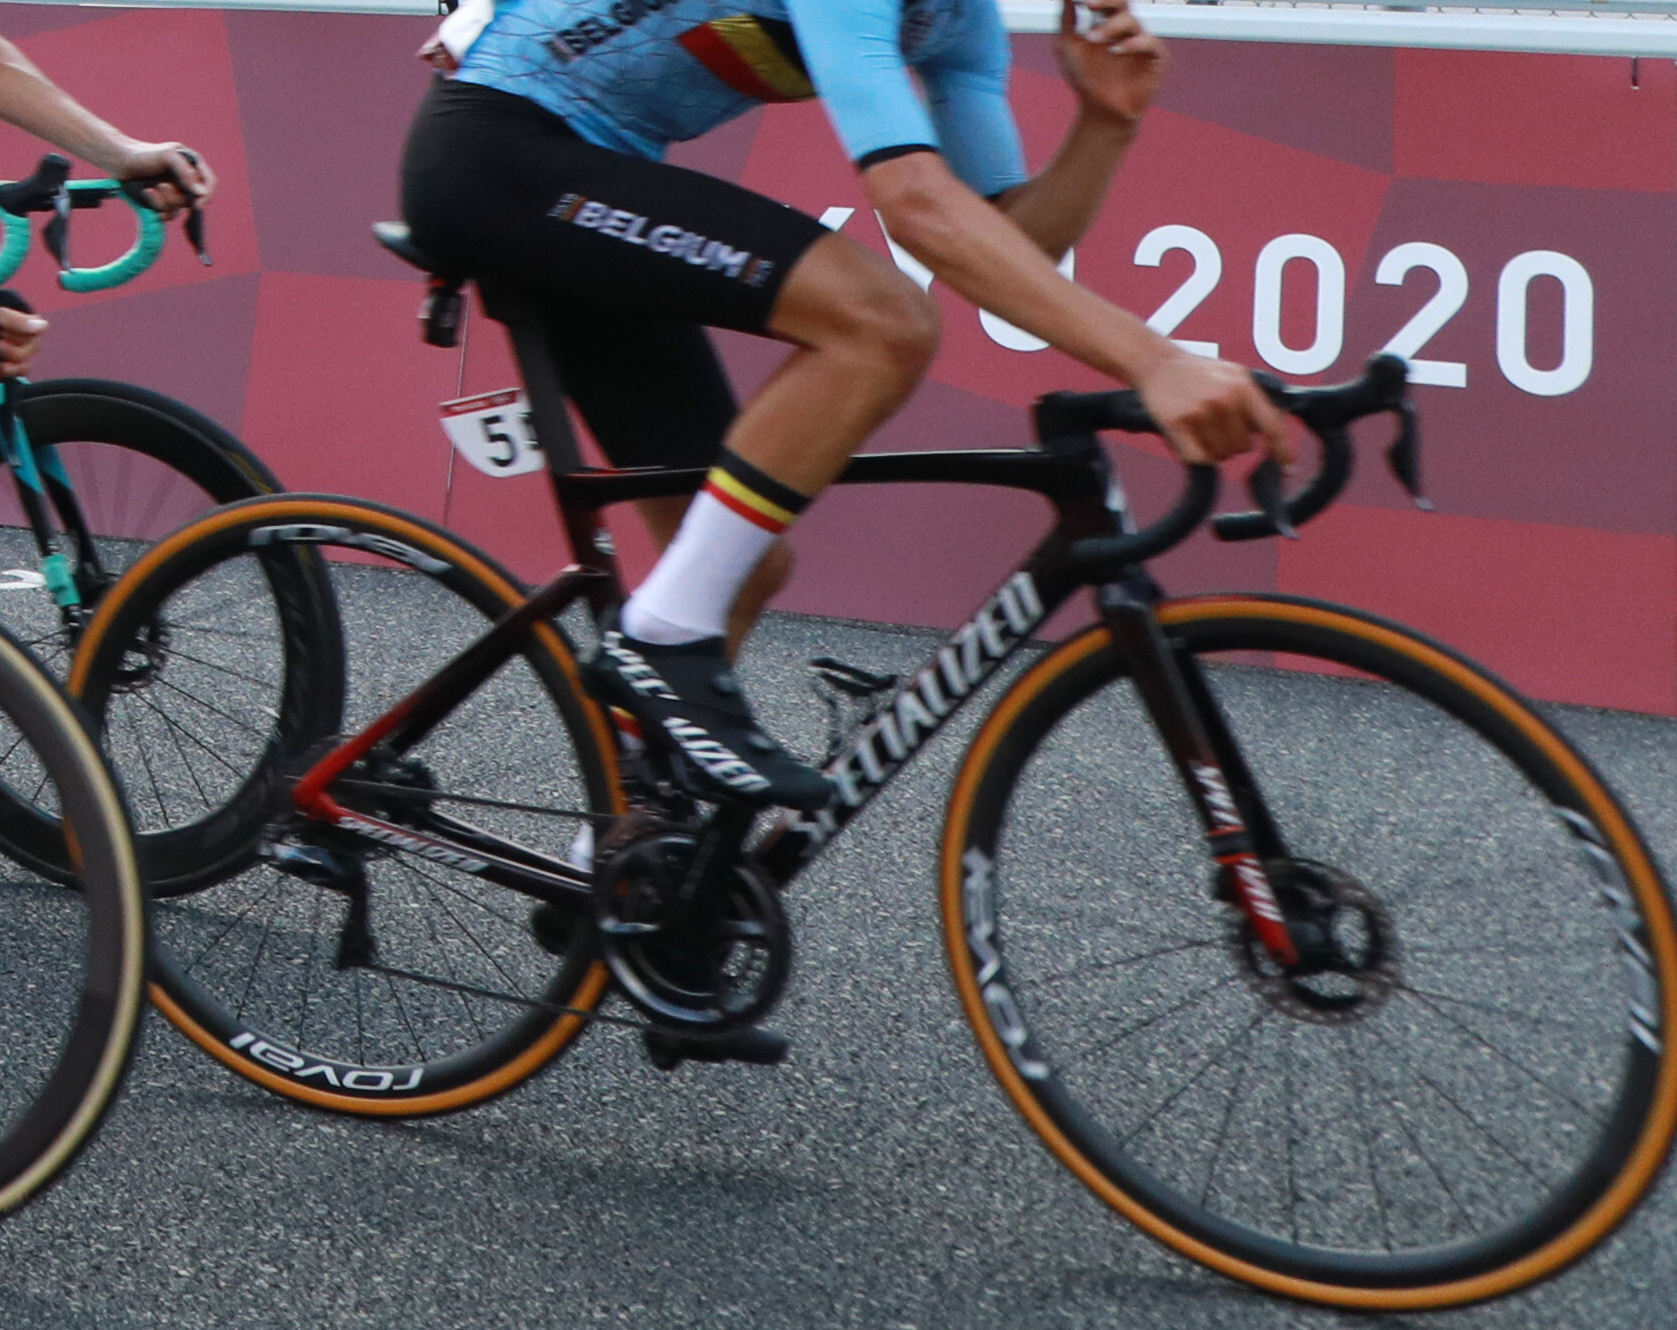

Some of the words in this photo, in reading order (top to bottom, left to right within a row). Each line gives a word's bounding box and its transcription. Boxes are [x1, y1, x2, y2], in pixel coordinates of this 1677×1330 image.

[577, 199, 750, 276] BELGIUM
[1130, 223, 1595, 397] 2020
[230, 1031, 424, 1092] roval
